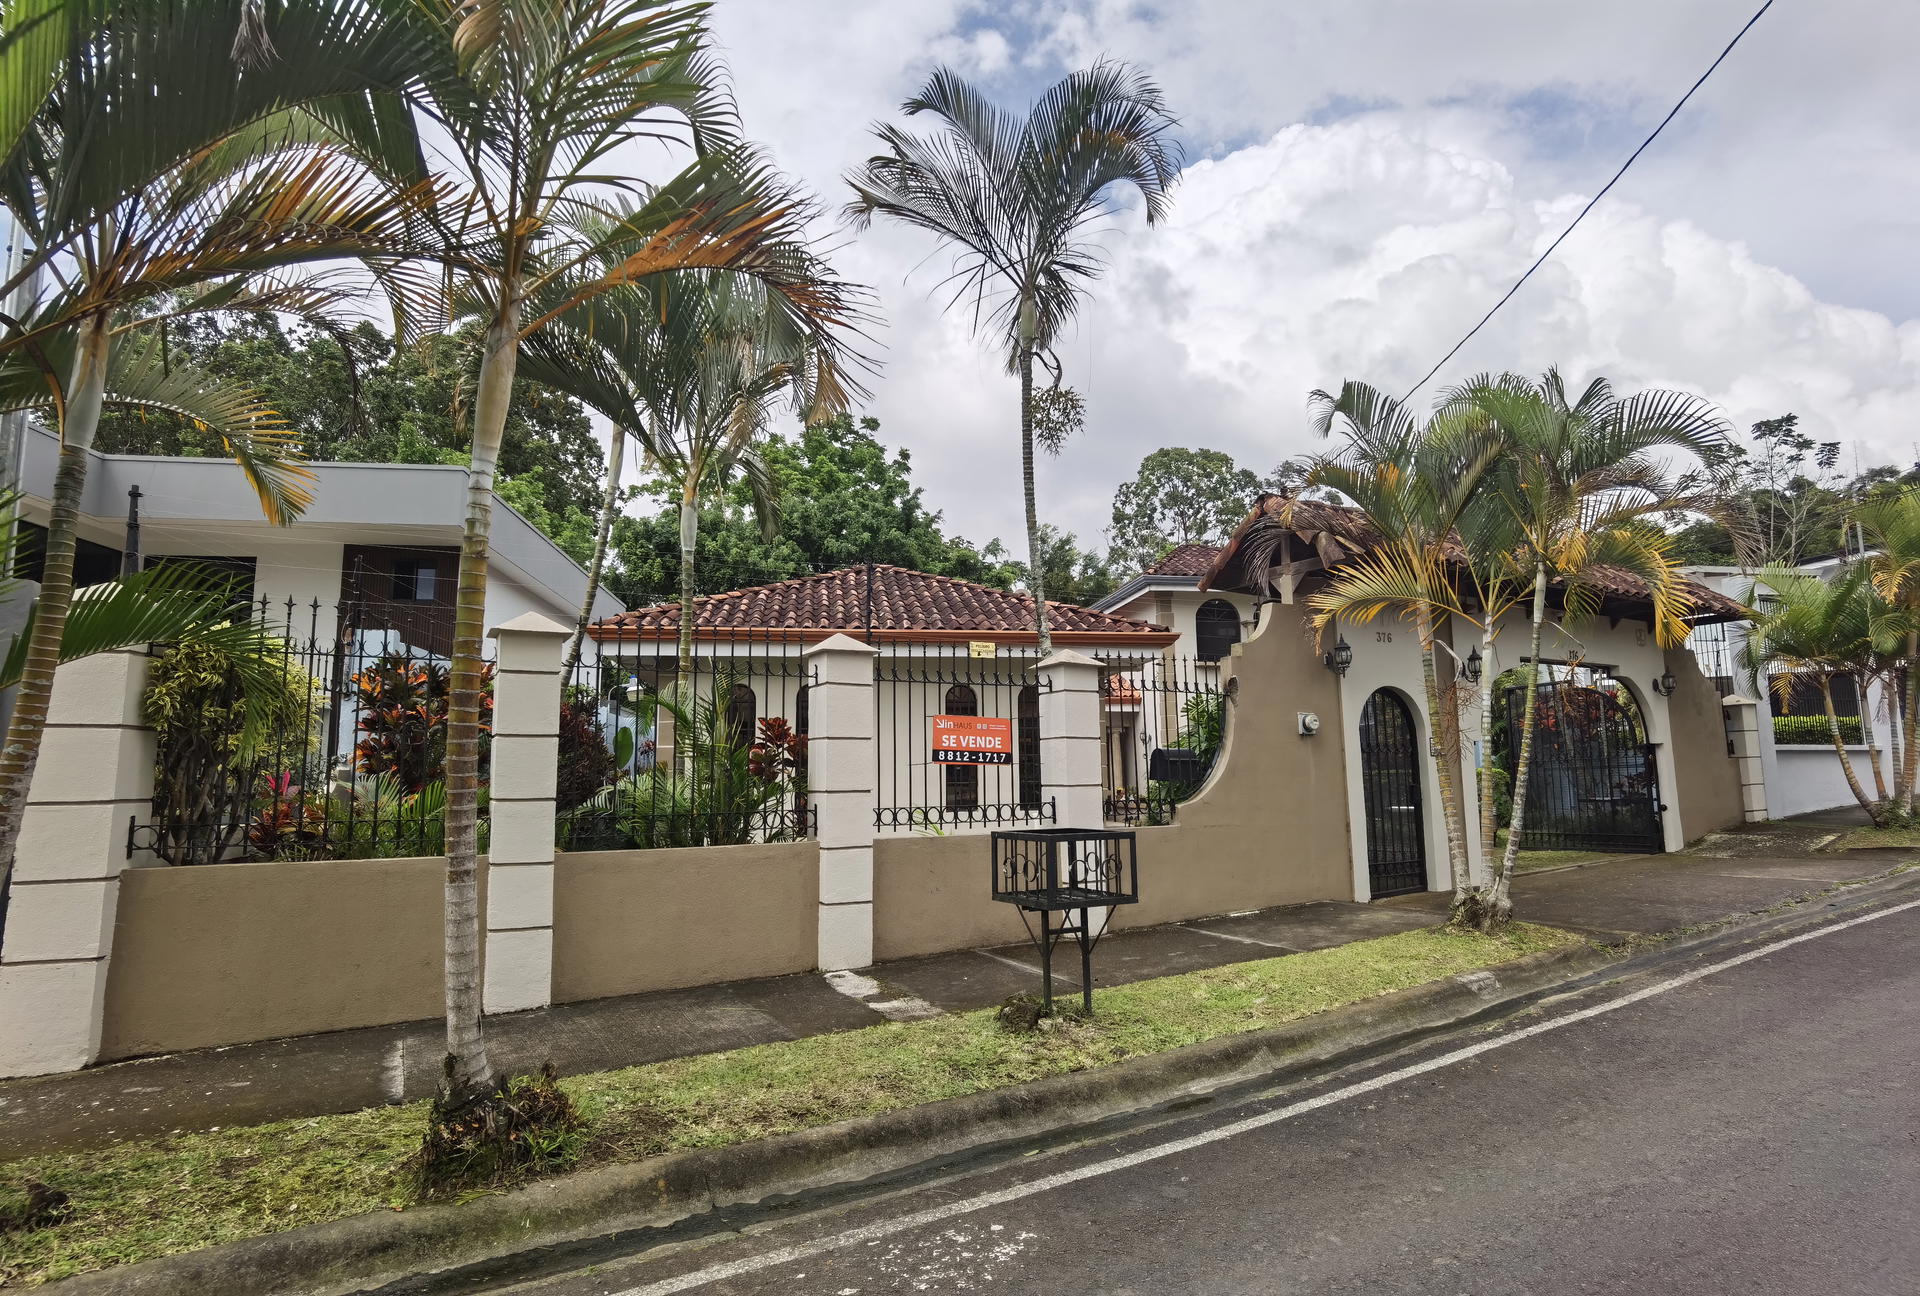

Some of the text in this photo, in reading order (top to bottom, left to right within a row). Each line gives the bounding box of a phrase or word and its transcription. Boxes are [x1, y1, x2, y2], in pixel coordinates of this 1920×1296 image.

[1376, 632, 1392, 643] 376
[942, 735, 1002, 748] SE VENDE
[938, 751, 1006, 763] 8812-1717
